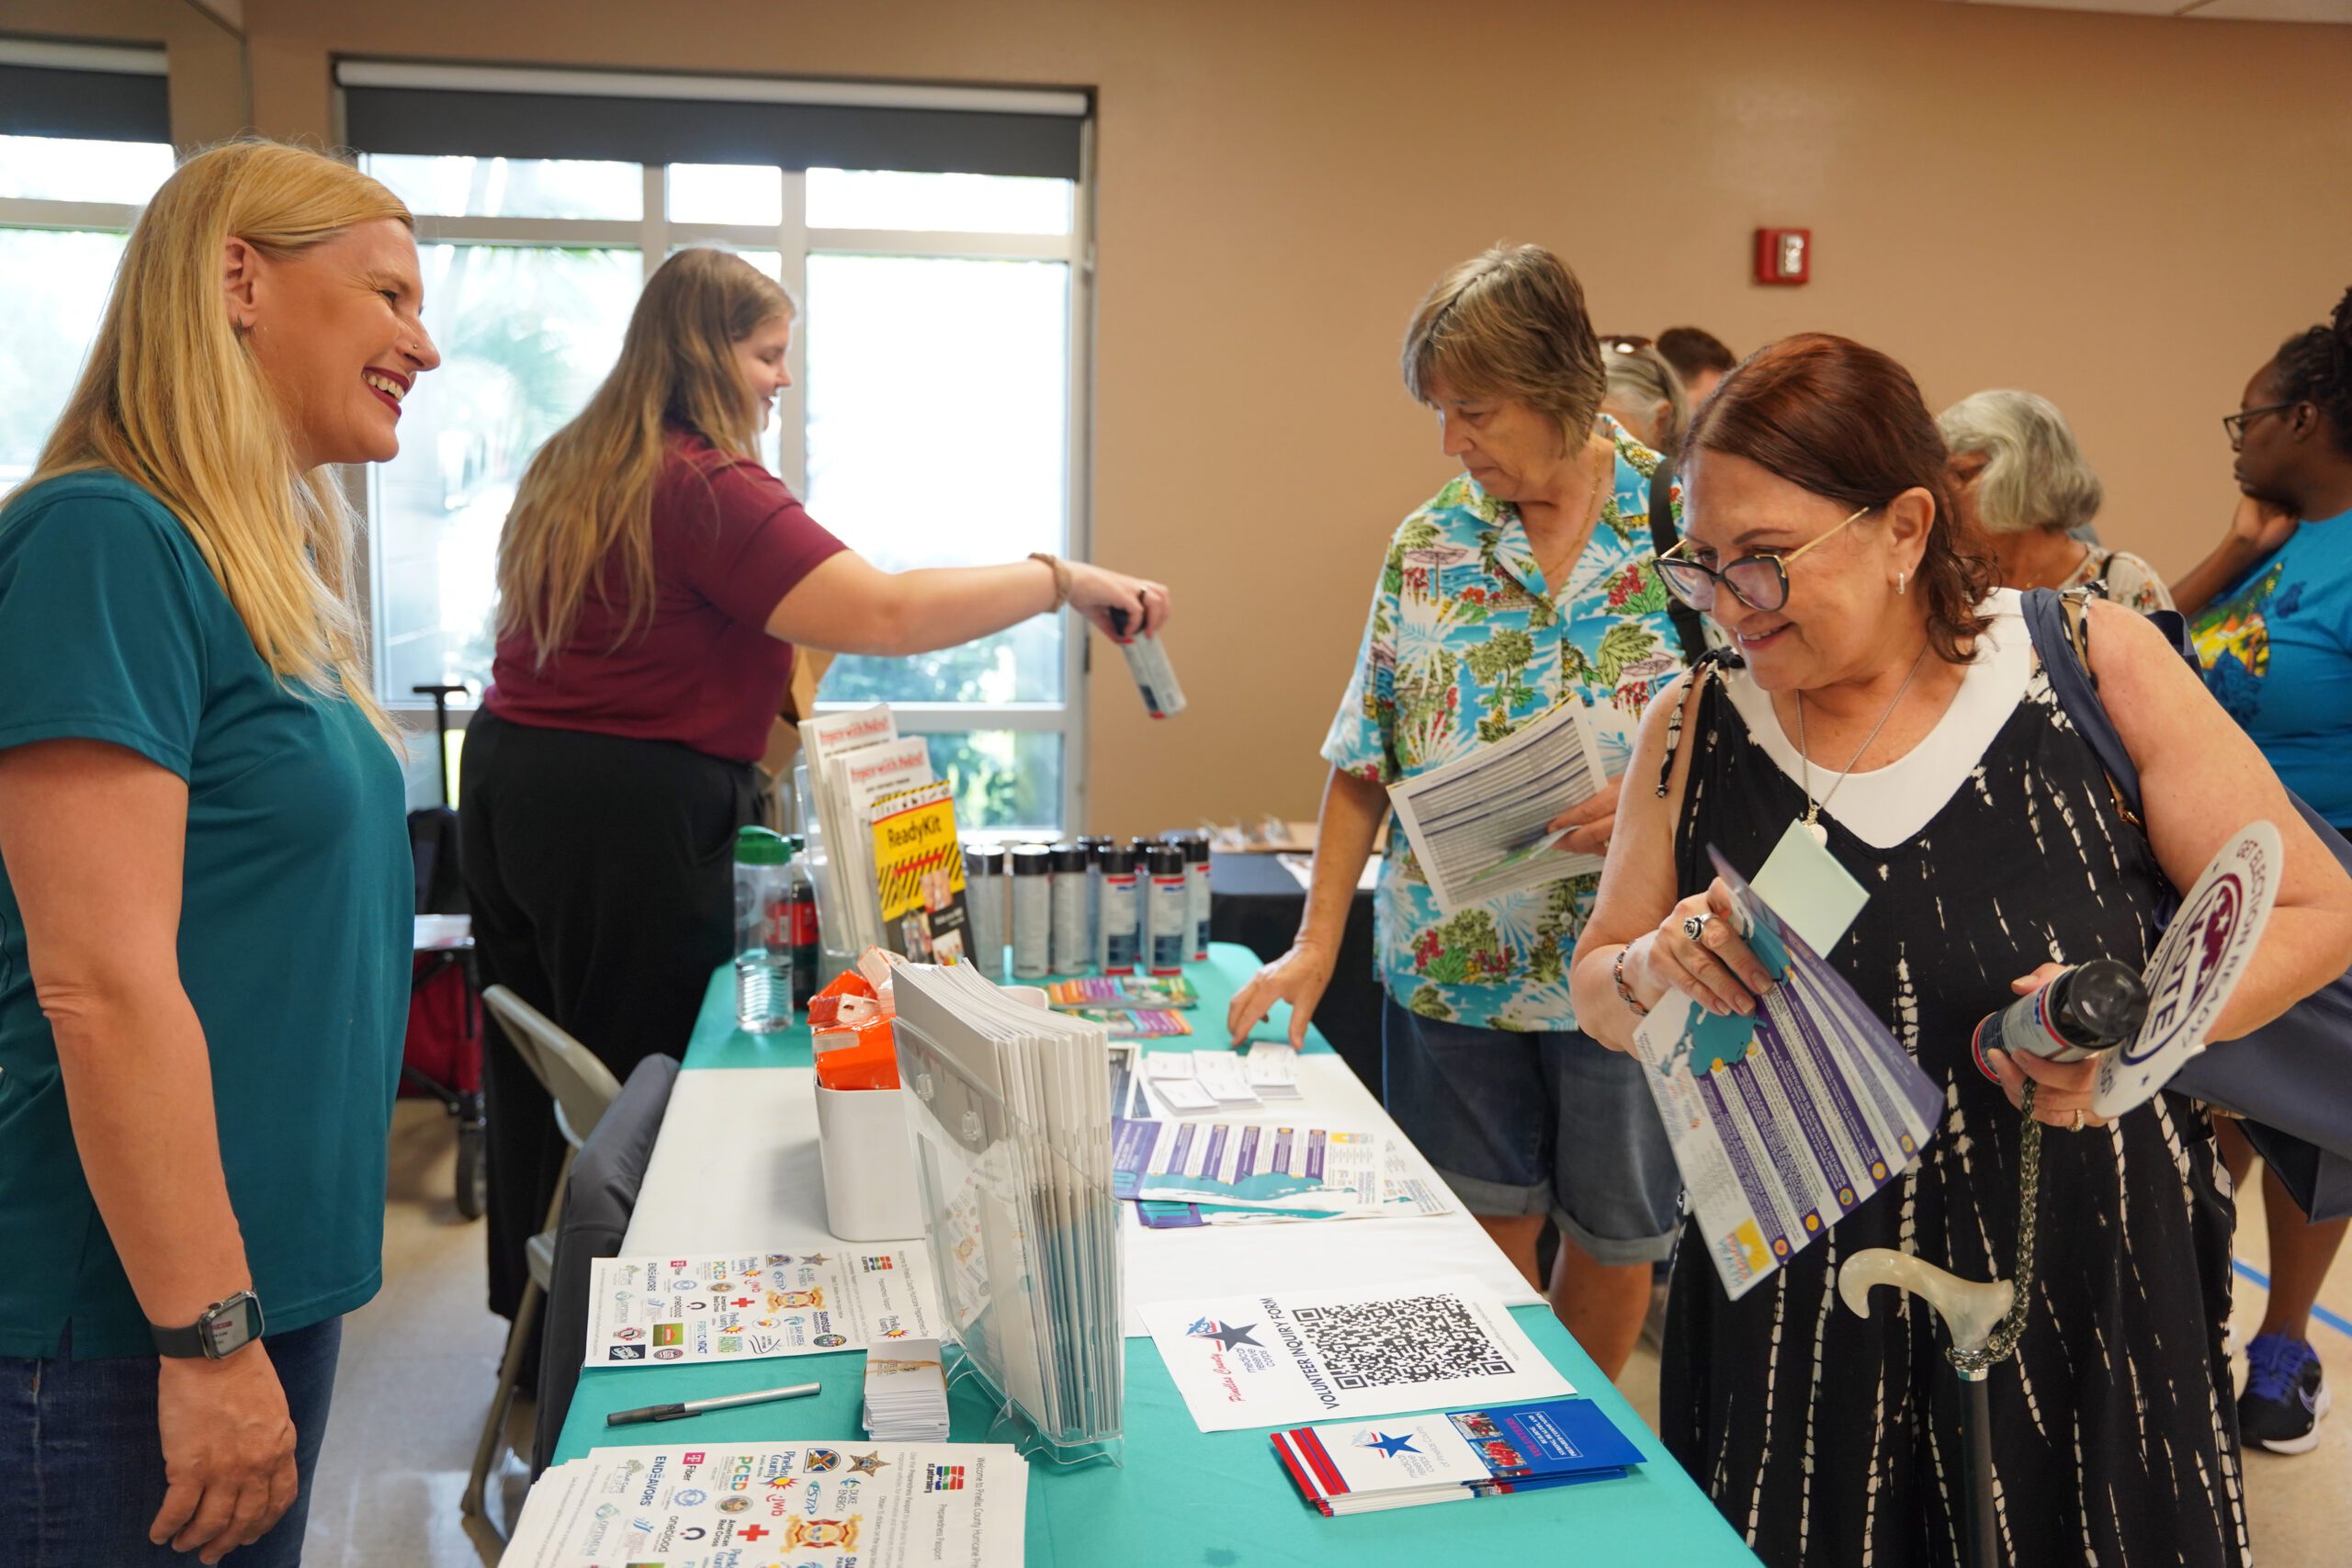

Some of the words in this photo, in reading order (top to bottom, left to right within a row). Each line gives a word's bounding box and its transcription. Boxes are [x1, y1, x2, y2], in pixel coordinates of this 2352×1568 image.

[887, 815, 943, 850] ReadyKit
[2236, 840, 2258, 861] GET
[2234, 849, 2266, 946] ELECTION
[2151, 893, 2214, 1039] VOTE
[1760, 1051, 1776, 1081] SERVICIOS
[1783, 1059, 1806, 1101] CERTIFICADOS
[1803, 1100, 1812, 1111] DE
[1807, 1110, 1828, 1146] NACIMIENTO
[1826, 1149, 1849, 1186] DEFUNCIÓN
[647, 1262, 657, 1292] ENDEAVORS
[713, 1260, 727, 1280] PCED
[1260, 1297, 1285, 1320] FORM
[1273, 1321, 1306, 1358] INQUIRY
[1210, 1353, 1232, 1375] County
[1234, 1347, 1257, 1373] medical
[1247, 1348, 1266, 1371] reserve
[1259, 1349, 1276, 1368] corps
[1222, 1376, 1246, 1403] Pinellas
[1296, 1358, 1340, 1410] VOLUNTEER
[1505, 1417, 1543, 1458] VOLUNTEERS
[684, 1465, 696, 1481] Fiber
[730, 1455, 754, 1491] PCED
[764, 1454, 783, 1478] County
[780, 1451, 796, 1476] Pinellas
[975, 1457, 985, 1482] Welcome
[1396, 1454, 1419, 1479] medical
[1408, 1455, 1427, 1476] reserve
[1419, 1456, 1435, 1472] corps
[639, 1455, 667, 1506] ENDEAVORS
[905, 1469, 915, 1497] Preparedness
[805, 1483, 819, 1509] PSTA
[848, 1489, 859, 1505] DUKE
[974, 1489, 985, 1507] Pinellas
[717, 1518, 727, 1529] Red
[935, 1504, 947, 1537] Preparedness
[970, 1507, 984, 1529] County
[586, 1520, 609, 1557] OPTIMUM
[658, 1515, 679, 1552] oneblood
[711, 1529, 724, 1547] Cross
[721, 1518, 737, 1547] American
[970, 1529, 983, 1558] Hurricane
[933, 1537, 945, 1561] Passport
